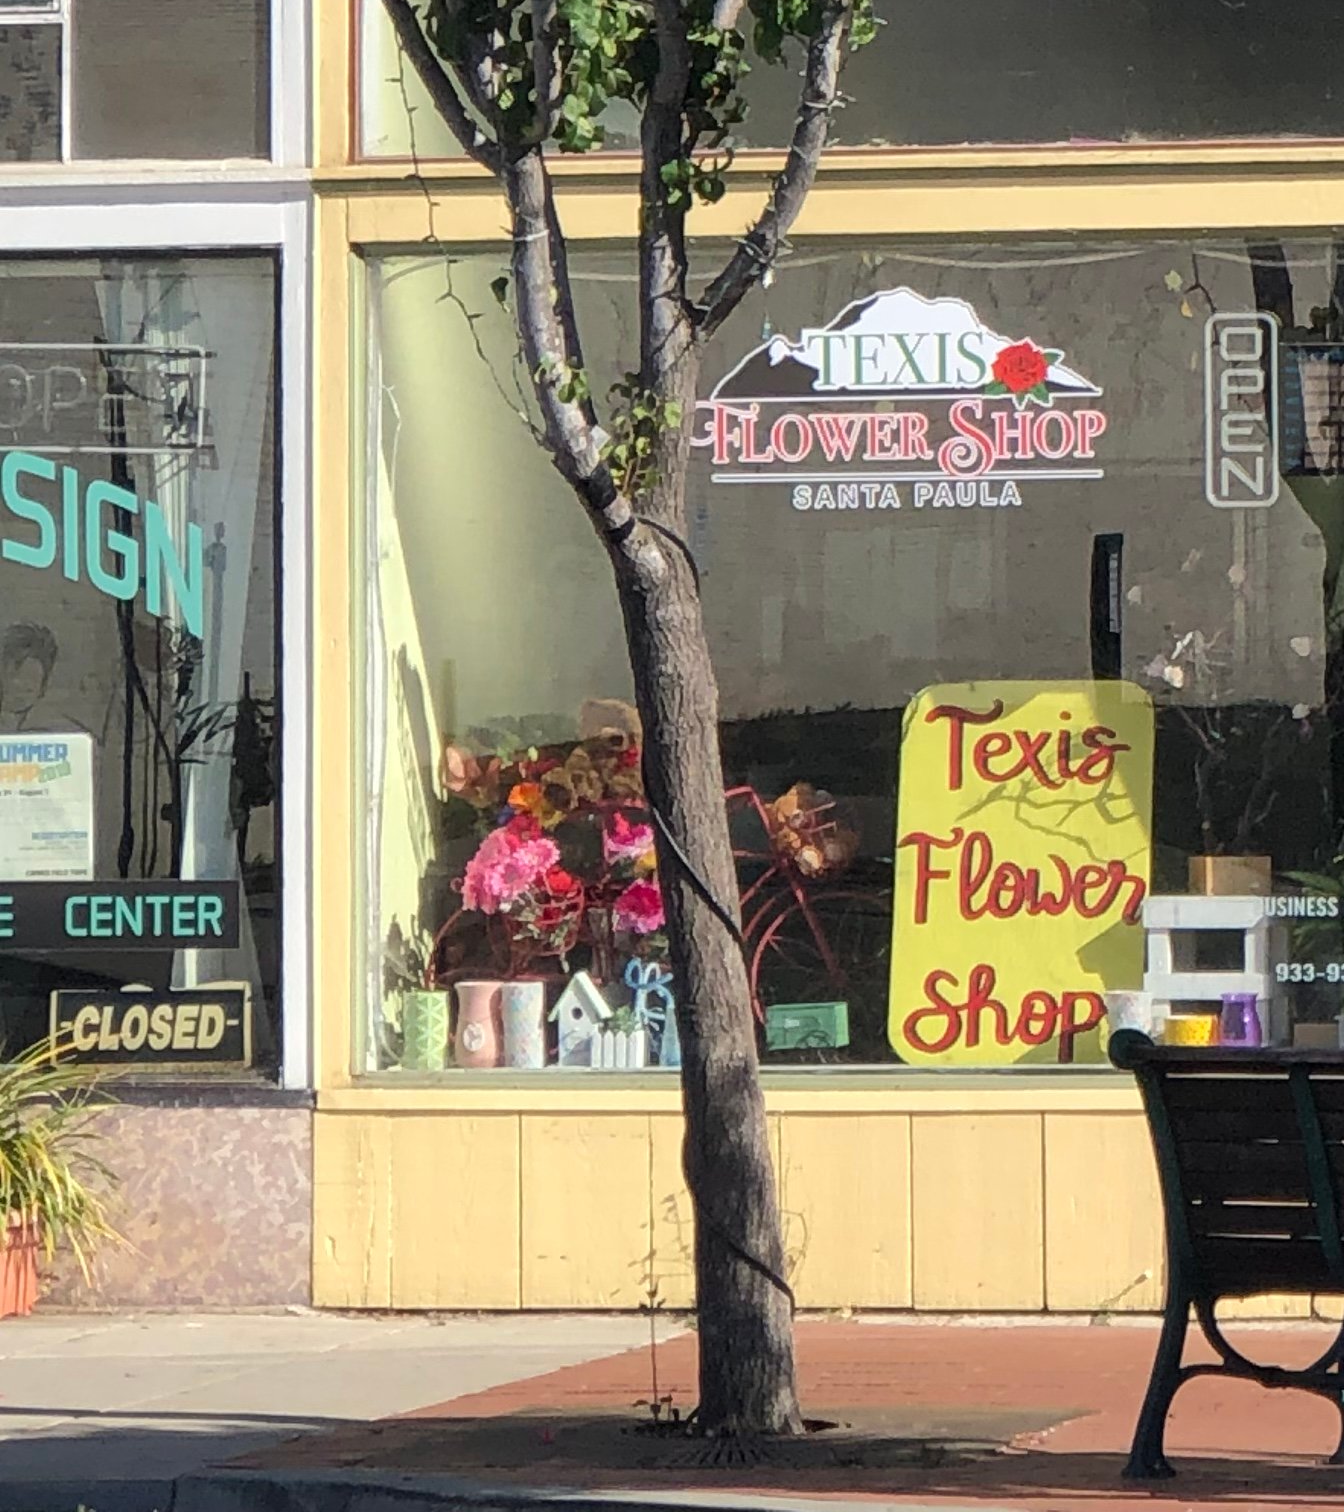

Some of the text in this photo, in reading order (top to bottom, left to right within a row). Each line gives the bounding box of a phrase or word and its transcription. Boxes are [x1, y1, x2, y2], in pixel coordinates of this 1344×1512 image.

[807, 330, 987, 387] TEXIS
[691, 399, 1107, 477] FLOWER SHOP
[1220, 326, 1264, 497] OPEN
[792, 481, 1022, 510] SANTA PAULA
[2, 451, 203, 639] SIGN
[925, 699, 1131, 790] Texis
[65, 895, 223, 937] CENTER
[898, 828, 1146, 925] Flower
[1258, 897, 1338, 917] USINESS
[902, 964, 1107, 1063] Shop
